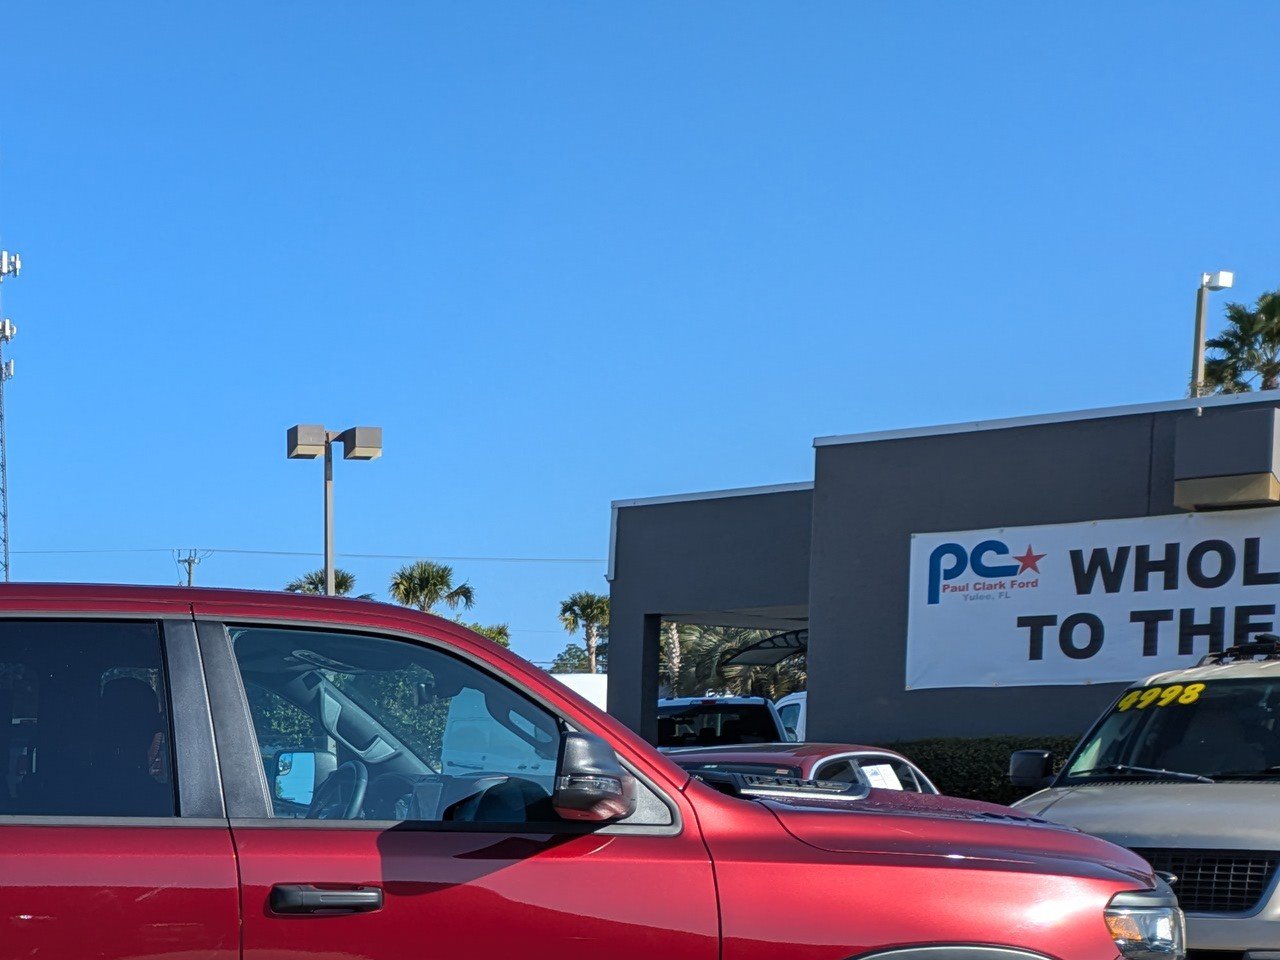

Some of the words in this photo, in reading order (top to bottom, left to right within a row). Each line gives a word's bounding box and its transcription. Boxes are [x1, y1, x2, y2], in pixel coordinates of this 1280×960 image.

[942, 583, 969, 593] Paul
[973, 581, 1006, 591] Clark
[1010, 579, 1039, 589] Ford
[1070, 537, 1280, 595] WHOL
[1017, 612, 1105, 660] TO
[1130, 604, 1276, 656] THE
